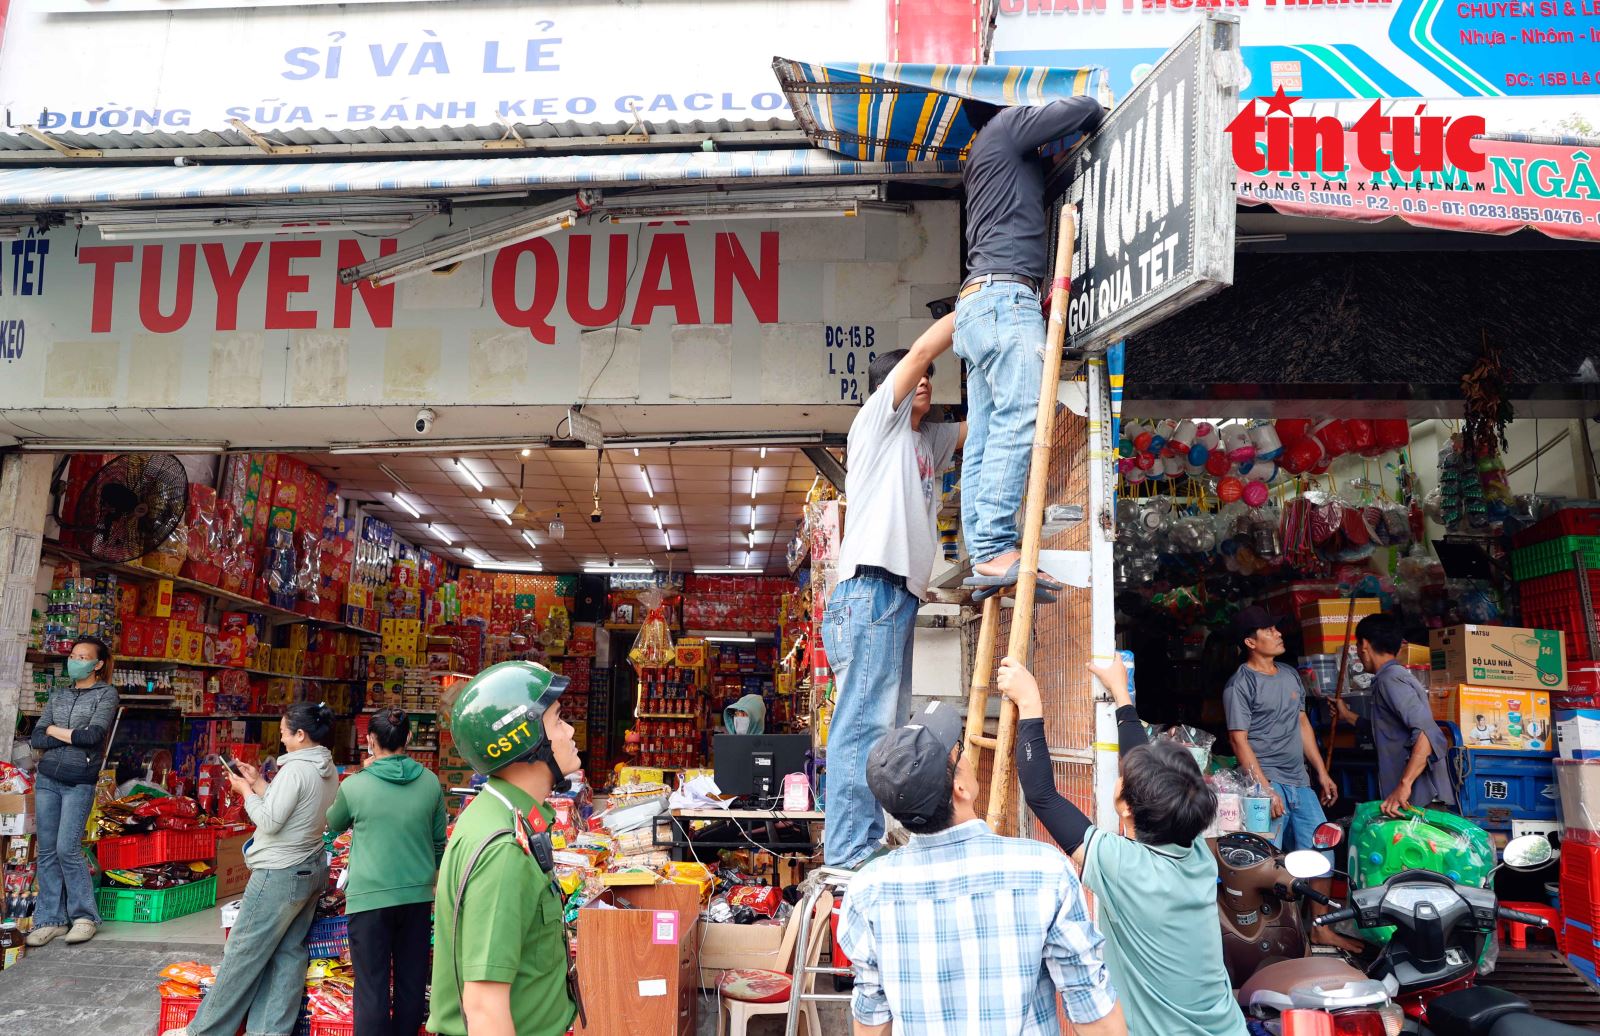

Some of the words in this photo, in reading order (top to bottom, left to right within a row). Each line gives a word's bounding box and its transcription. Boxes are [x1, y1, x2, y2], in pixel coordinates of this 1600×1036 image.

[1563, 1, 1576, 17] &
[281, 31, 346, 80] SỈ
[369, 29, 450, 77] VÀ
[482, 20, 563, 73] LẺ
[1459, 29, 1506, 47] Nhựa
[1521, 27, 1574, 43] Nhôm
[1505, 73, 1534, 87] ĐC:
[1538, 73, 1567, 86] 15B
[1571, 72, 1591, 86] Lê
[37, 102, 192, 130] ĐƯỜNG
[223, 97, 314, 123] SỮA
[497, 95, 597, 122] KẸO
[1310, 192, 1352, 208] SUNG
[1367, 196, 1389, 210] P.2
[1403, 199, 1427, 213] Q.6
[1442, 201, 1465, 216] ĐT:
[1469, 203, 1583, 224] 0283.855.0476
[491, 212, 780, 345] QUÂN
[1099, 252, 1133, 318] QUÀ
[1139, 220, 1179, 296] TẾT
[1472, 656, 1482, 667] BỘ
[1483, 658, 1497, 666] LAU
[487, 721, 532, 758] CSTT
